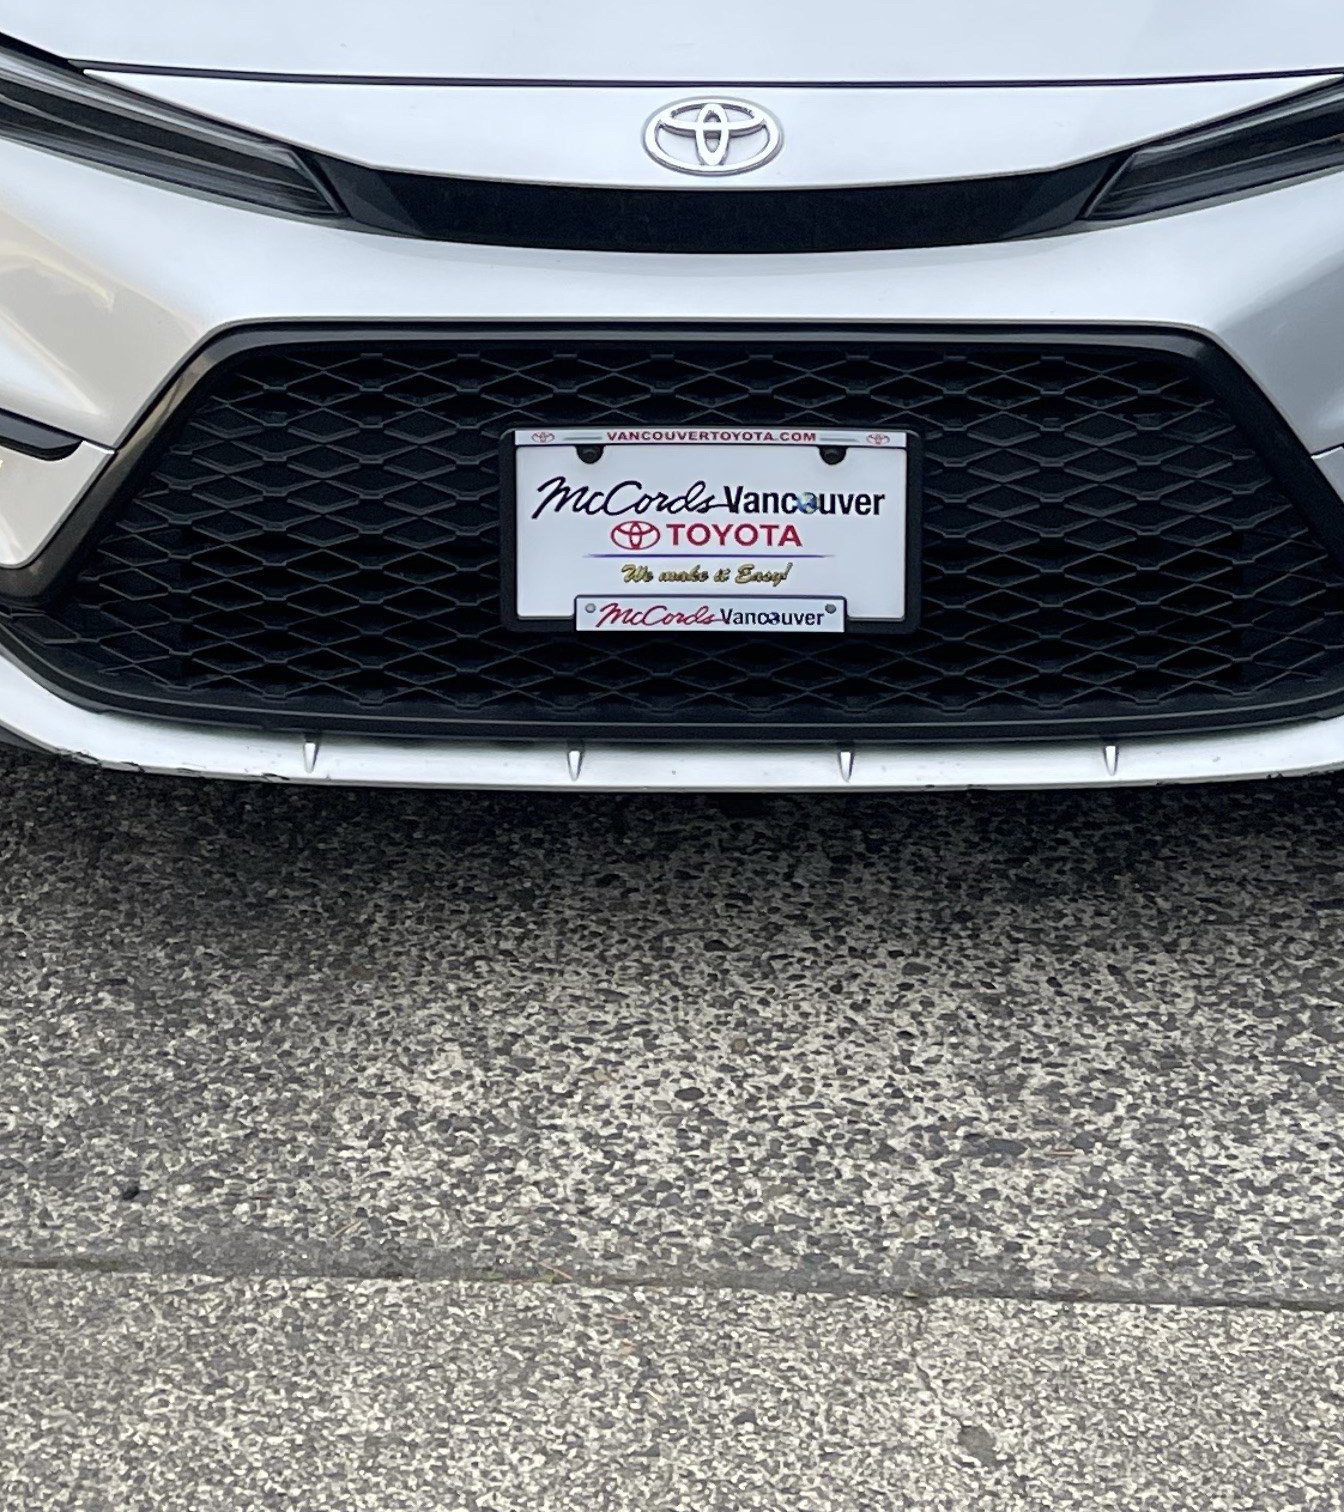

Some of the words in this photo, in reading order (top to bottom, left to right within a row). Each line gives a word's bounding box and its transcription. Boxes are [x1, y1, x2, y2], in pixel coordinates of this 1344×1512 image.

[606, 430, 817, 443] VANCOUVERTOYOTA.COM
[531, 476, 729, 520] McCords
[723, 485, 886, 517] Vancouver
[666, 523, 804, 547] TOYOTA
[621, 563, 654, 584] We
[658, 563, 709, 584] make
[713, 567, 732, 583] it
[734, 561, 794, 588] Easy!
[595, 602, 723, 628] McCords
[719, 607, 825, 626] Vancouver
